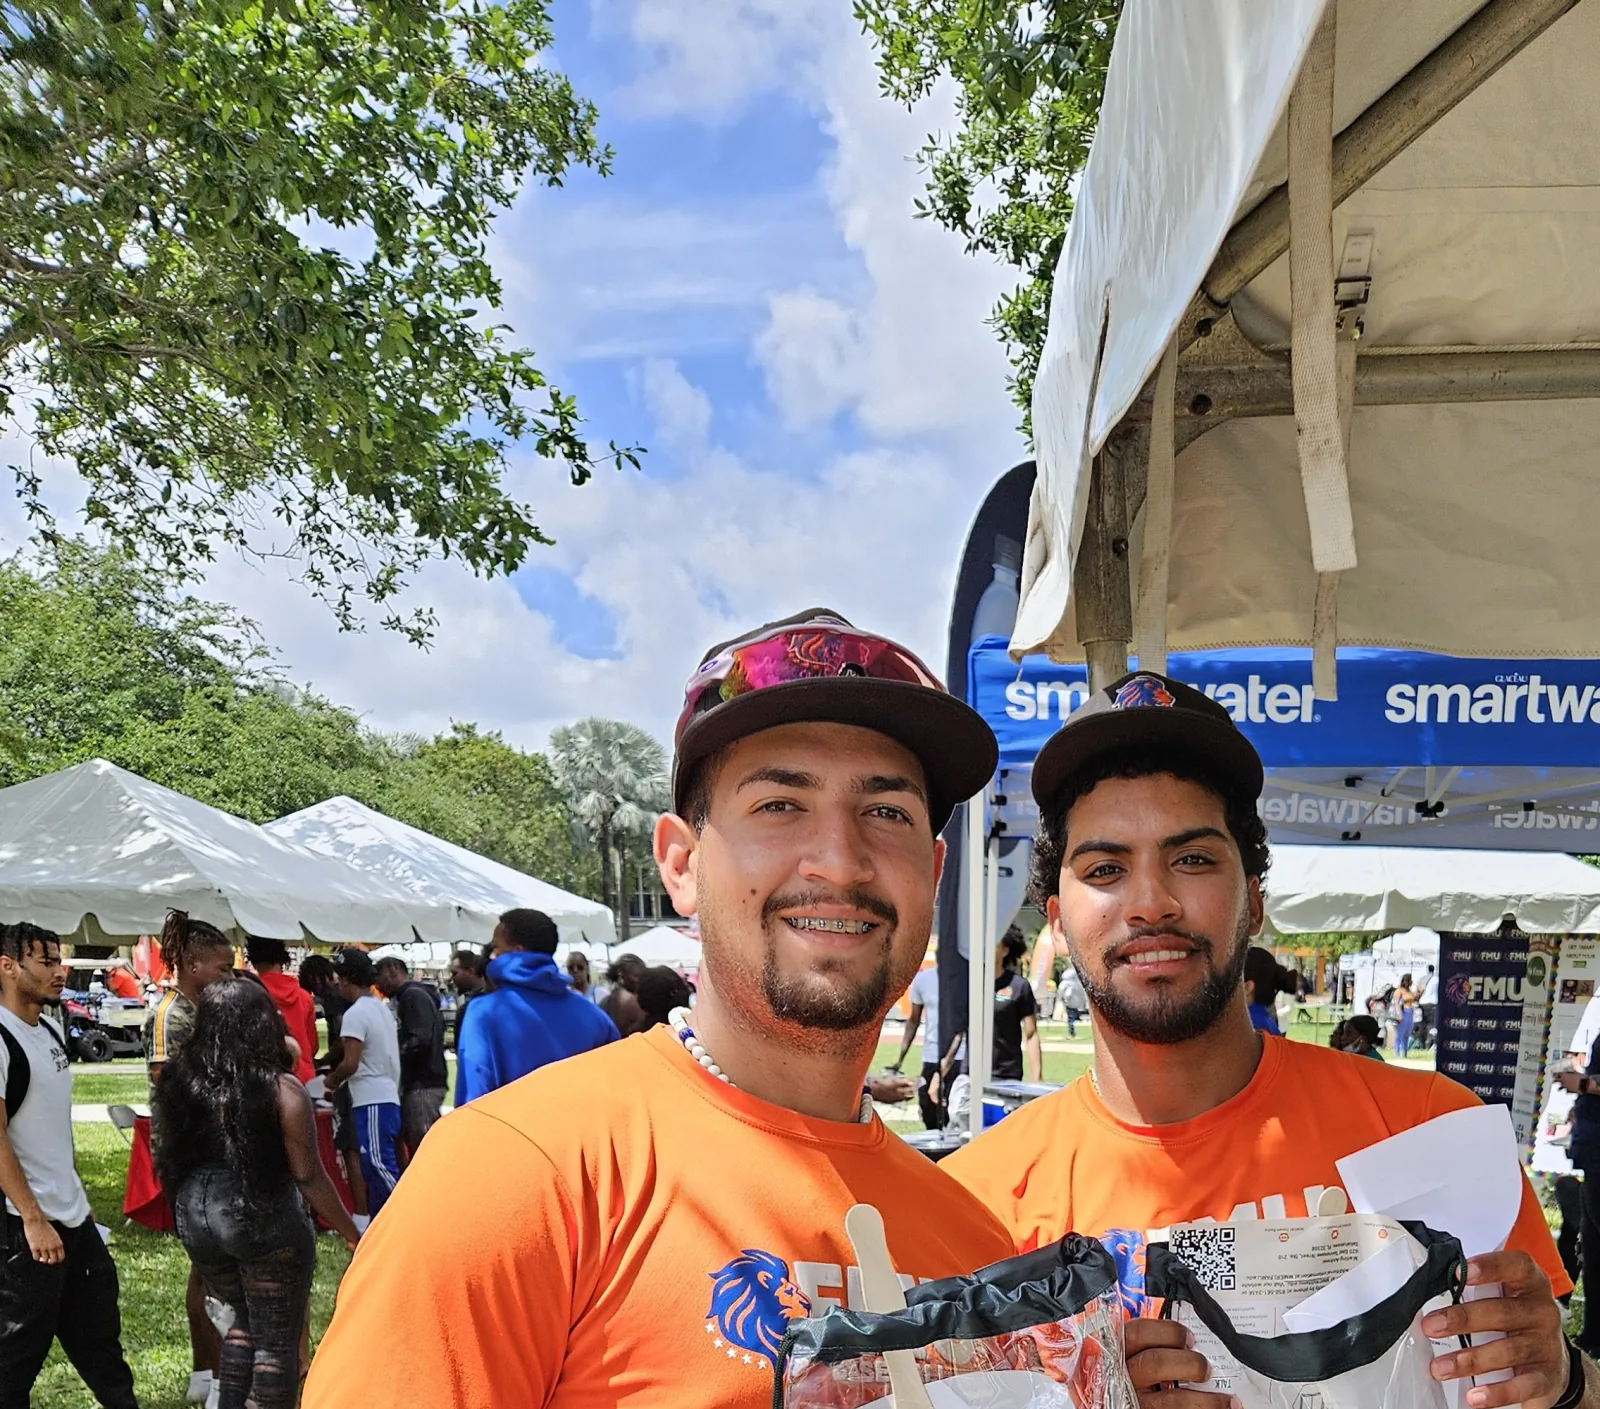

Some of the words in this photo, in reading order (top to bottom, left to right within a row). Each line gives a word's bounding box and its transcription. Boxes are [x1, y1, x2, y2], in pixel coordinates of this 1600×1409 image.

[1495, 673, 1528, 683] GLACÉAU
[1453, 951, 1471, 960] FMU
[1481, 951, 1500, 960] FMU
[1468, 976, 1526, 1001] FMU
[1450, 1018, 1468, 1027] FMU
[1477, 1020, 1496, 1028] FMU
[1449, 1041, 1467, 1049] FMU
[1476, 1042, 1495, 1050] FMU
[1448, 1063, 1465, 1071] FMU
[1475, 1064, 1493, 1072] FMU
[1215, 1379, 1231, 1388] TALK
